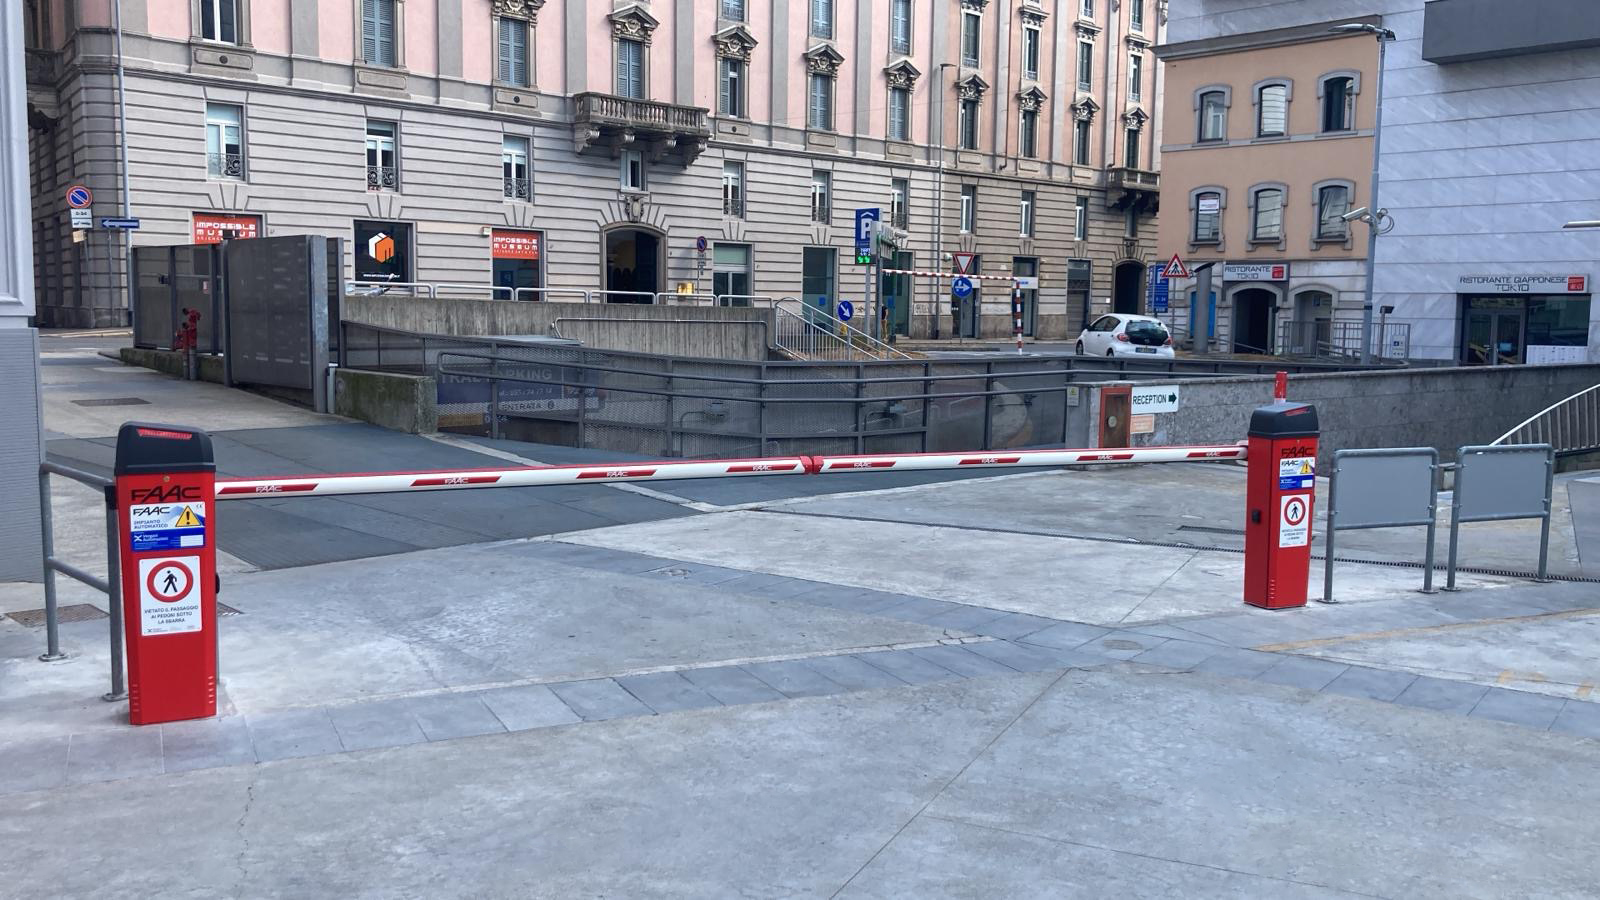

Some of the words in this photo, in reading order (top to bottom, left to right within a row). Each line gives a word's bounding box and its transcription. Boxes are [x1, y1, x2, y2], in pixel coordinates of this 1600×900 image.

[196, 222, 256, 230] IMPOSSIBLE
[493, 236, 538, 244] IMPOSSIBLE
[1224, 265, 1271, 273] RISTORANTE
[1459, 276, 1512, 284] RISTORANTE
[1513, 276, 1568, 284] GIAPPONESE
[1132, 394, 1167, 405] RECEPTION
[1281, 446, 1314, 458] FAAC
[255, 485, 283, 494] FAAC
[131, 485, 201, 504] FAAC
[132, 506, 171, 517] FAAC
[170, 604, 199, 612] PASSAGGIO
[157, 611, 176, 619] PEDONI
